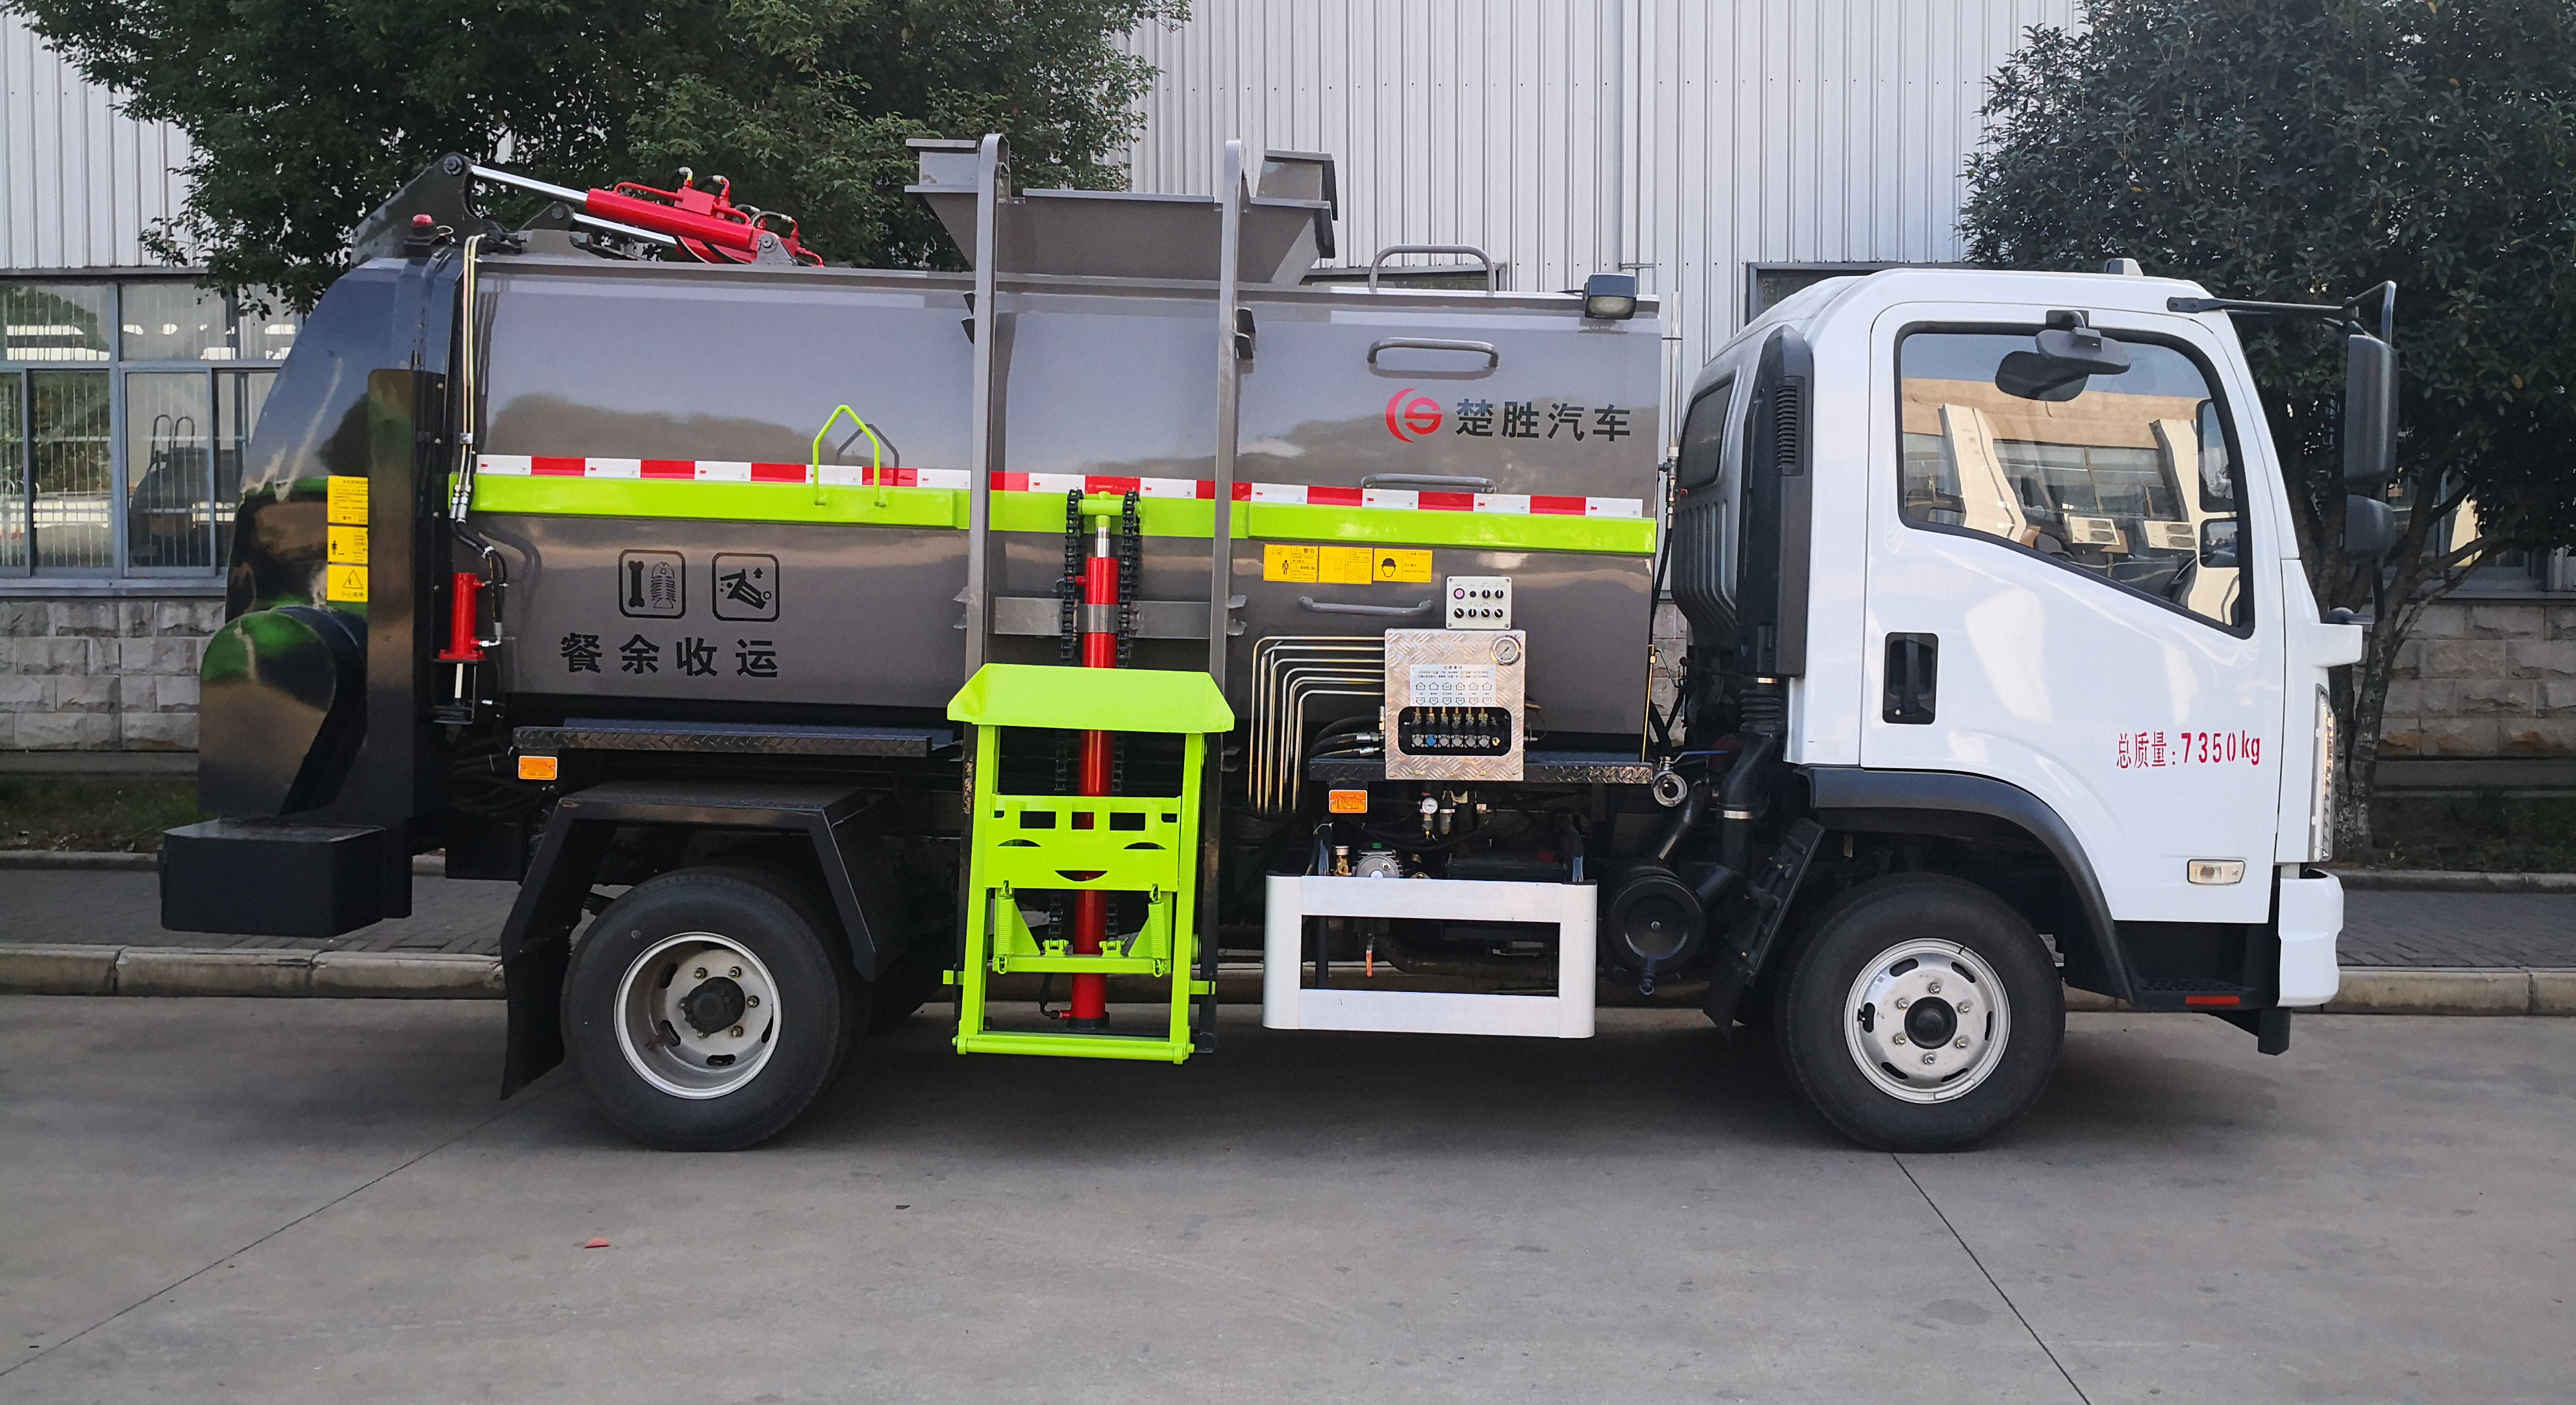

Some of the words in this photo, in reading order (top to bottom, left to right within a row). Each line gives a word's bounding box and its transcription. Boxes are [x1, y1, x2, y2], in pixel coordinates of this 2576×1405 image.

[1455, 397, 1631, 442] 楚胜汽车
[560, 632, 778, 678] 餐余收运
